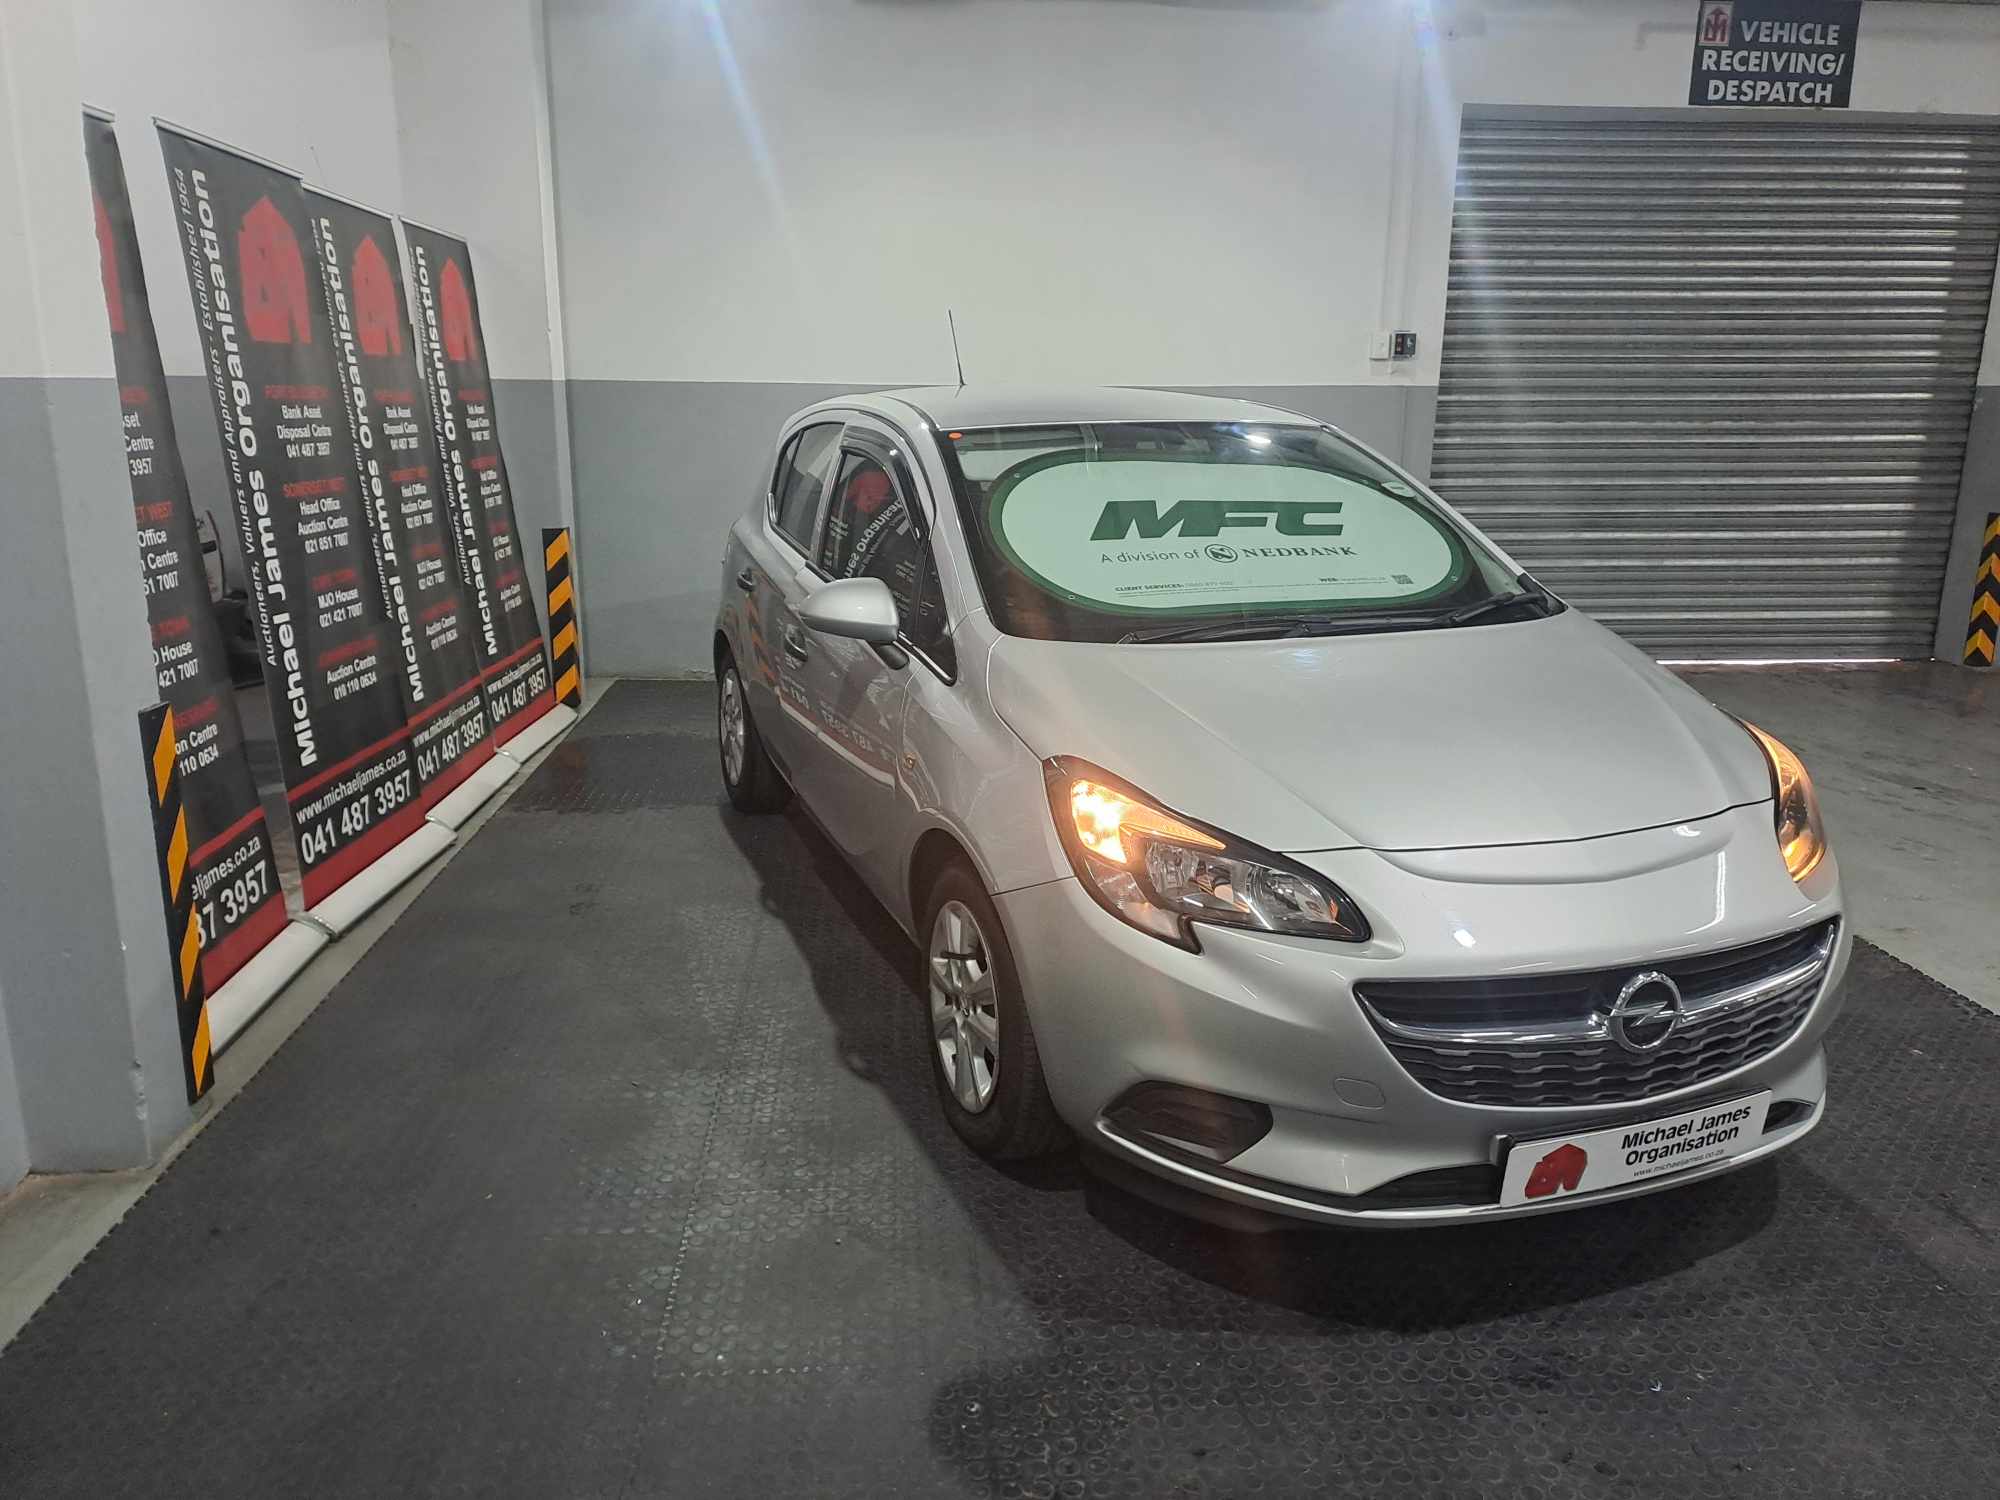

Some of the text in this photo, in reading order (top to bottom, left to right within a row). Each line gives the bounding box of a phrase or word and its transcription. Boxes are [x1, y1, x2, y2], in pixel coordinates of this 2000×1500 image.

[1741, 20, 1840, 46] VEHICLE
[1702, 50, 1845, 76] RECEIVING/
[1707, 79, 1833, 104] DESPATCH
[174, 167, 193, 216] 1964
[183, 221, 214, 331] Established
[320, 217, 373, 449] Organisation
[416, 246, 456, 441] Organisation
[210, 348, 236, 445] Appraisers
[122, 411, 141, 428] set
[276, 424, 310, 441] Disposal
[192, 169, 317, 767] Michael James Organisation
[227, 448, 242, 484] and
[368, 459, 397, 567] James
[451, 449, 476, 541] James
[138, 529, 167, 547] Office
[236, 489, 255, 554] Valuers
[1090, 500, 1343, 541] MFC
[147, 550, 178, 570] Centre
[1101, 546, 1358, 564] A division of NEDBANK
[157, 570, 179, 591] 7007
[467, 548, 498, 656] Michael
[252, 561, 278, 666] Auctioneers,
[161, 641, 193, 663] House
[388, 576, 424, 702] Michael
[158, 658, 199, 688] 421 7007
[327, 664, 353, 684] Auction
[491, 667, 547, 723] 041 487 3957
[189, 723, 218, 747] Centre
[417, 712, 485, 781] 041 487 3957
[179, 752, 197, 776] 110
[296, 750, 406, 824] www.michaeljames.co.za
[301, 769, 411, 864] 041 487 3957
[220, 860, 268, 924] 3957
[1621, 1106, 1752, 1150] Michael James
[1625, 1126, 1739, 1167] Organisation
